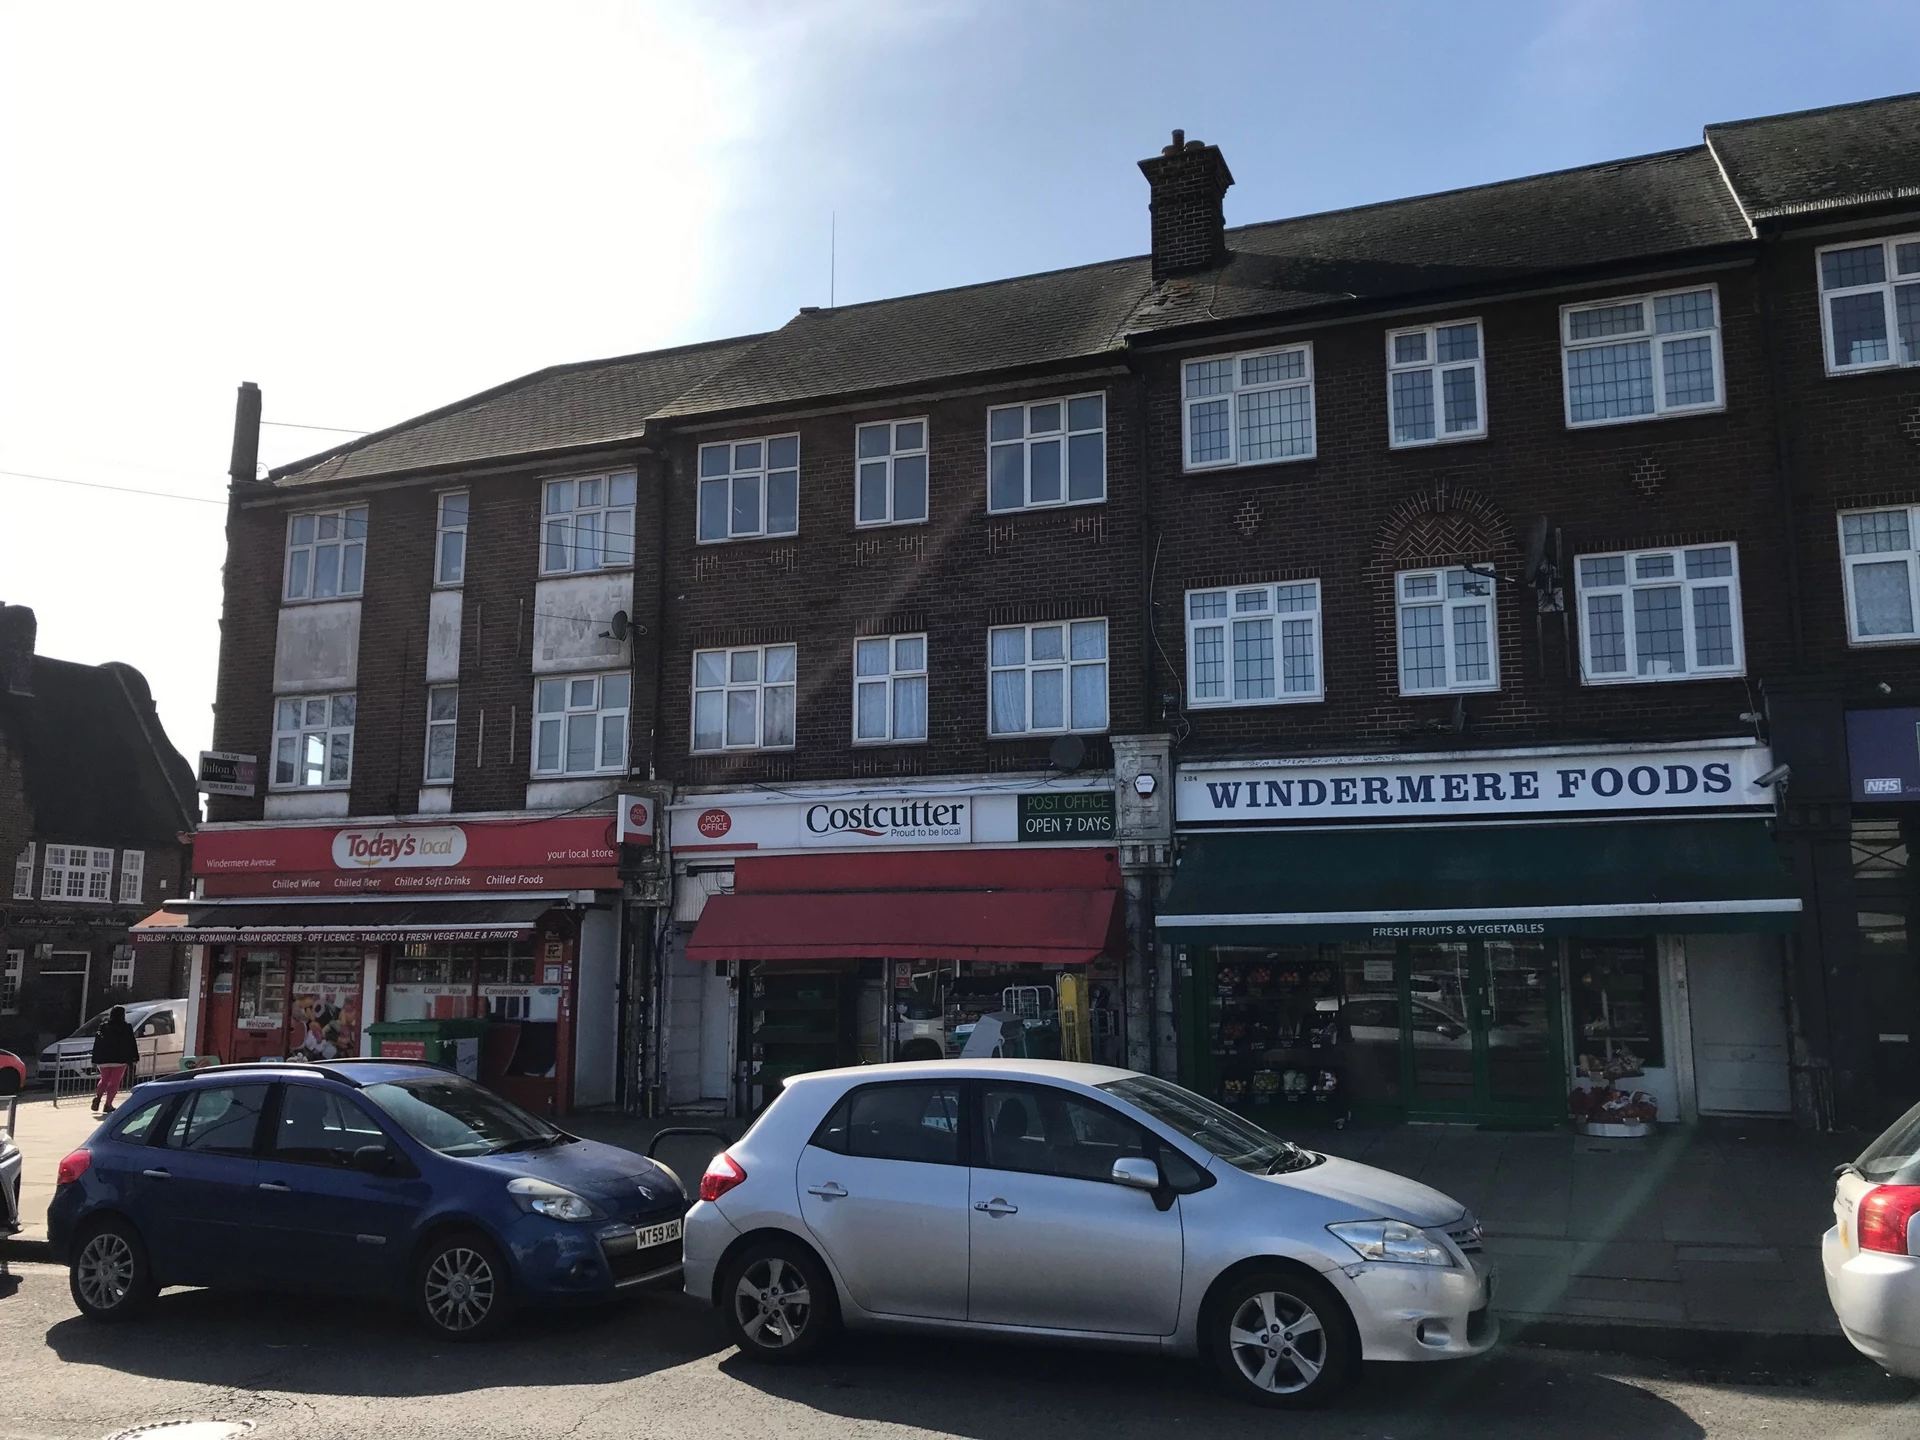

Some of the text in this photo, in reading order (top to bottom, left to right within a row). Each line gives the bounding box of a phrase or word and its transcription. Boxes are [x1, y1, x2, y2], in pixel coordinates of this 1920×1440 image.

[1206, 763, 1732, 809] WINDERMERE FOODS
[1866, 780, 1898, 792] NHS
[1027, 794, 1110, 810] POST OFFICE
[705, 814, 725, 823] POST
[806, 799, 964, 834] Costcutter
[700, 822, 728, 832] OFFICE
[1025, 816, 1111, 833] OPEN 7 DAYS
[890, 826, 962, 838] Proud to be local
[346, 832, 453, 862] Today's local
[547, 849, 614, 861] your local store
[206, 858, 276, 868] Windermere Avenue
[272, 878, 321, 888] Chilled Wine
[334, 877, 382, 887] Chilled Beer
[394, 875, 471, 886] Chilled Soft Drinks
[486, 874, 544, 885] Chilled Foods
[137, 934, 166, 942] ENGLISH
[170, 934, 195, 942] POLISH
[199, 933, 236, 942] ROMANIAN
[261, 933, 303, 942] GROCERIES
[308, 933, 323, 942] OFF
[323, 933, 355, 942] LICENCE
[361, 933, 397, 942] TABACCO
[398, 933, 404, 942] &
[405, 932, 433, 941] FRESH
[433, 931, 481, 941] VEGETABLE
[481, 931, 487, 939] &
[488, 930, 519, 939] FRUITS
[1372, 923, 1545, 937] FRESH FRUITS & VEGETABLES
[298, 984, 309, 993] For
[310, 984, 320, 993] All
[322, 984, 338, 993] Your
[423, 986, 442, 995] Local
[447, 986, 467, 995] Value
[484, 987, 529, 995] Convenience
[246, 1020, 275, 1028] Welcome
[639, 1223, 680, 1246] MT59 XBK
